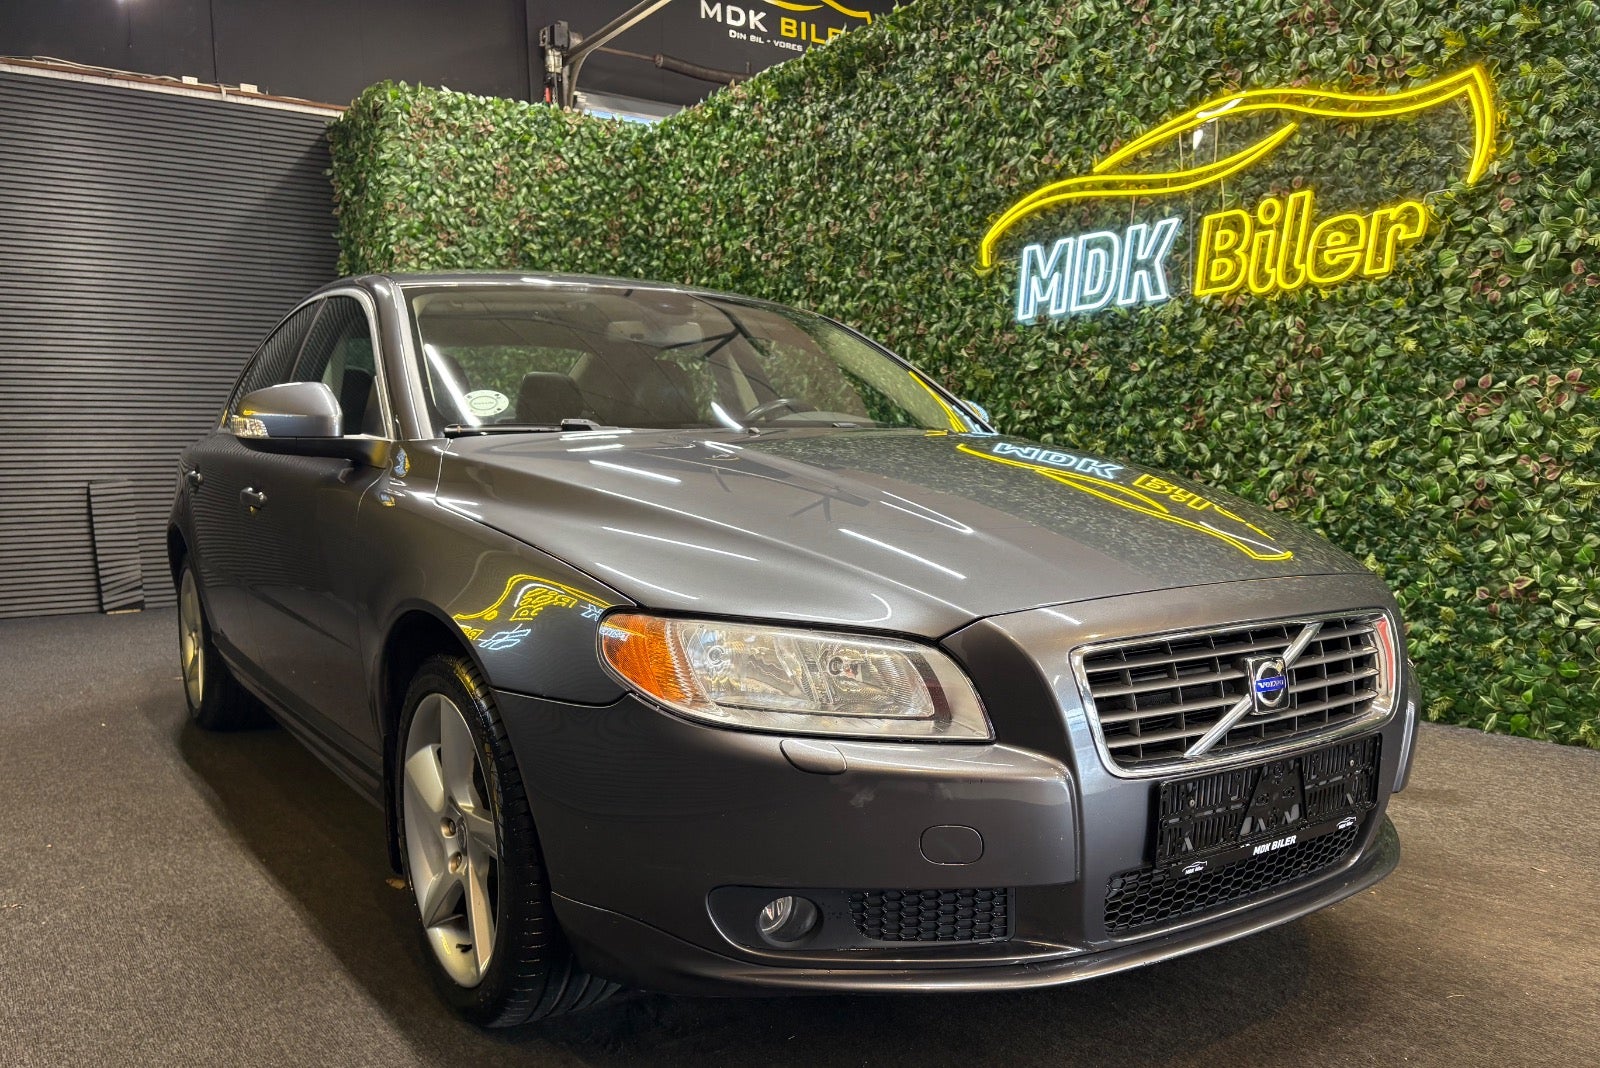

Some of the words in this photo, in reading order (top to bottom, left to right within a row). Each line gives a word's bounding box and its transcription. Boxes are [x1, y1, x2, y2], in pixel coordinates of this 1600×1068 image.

[700, 0, 768, 32] MDK
[780, 16, 852, 45] BIL
[728, 29, 747, 40] DIN
[749, 34, 765, 44] BIL
[773, 39, 803, 52] VORES
[1017, 216, 1183, 322] MDK
[1194, 190, 1428, 297] Biler
[1252, 842, 1272, 856] MDK
[1270, 834, 1297, 851] BILER
